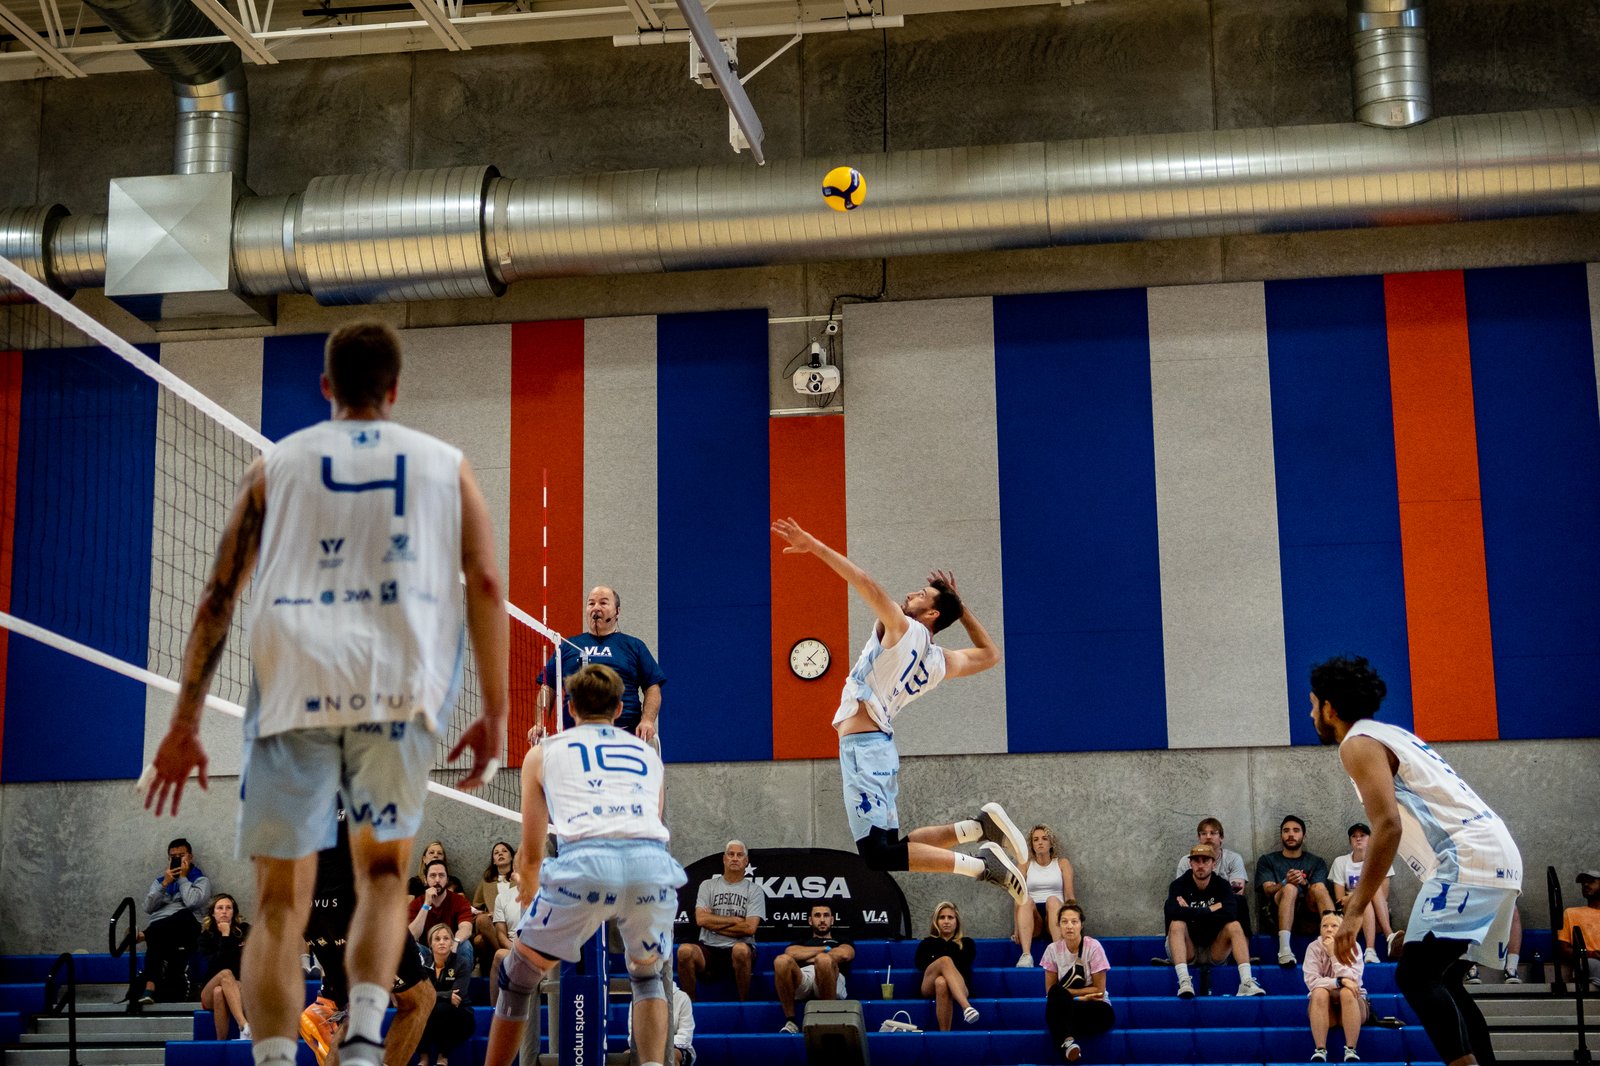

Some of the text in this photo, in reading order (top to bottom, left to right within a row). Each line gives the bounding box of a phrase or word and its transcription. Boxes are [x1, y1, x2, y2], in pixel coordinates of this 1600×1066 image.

[321, 454, 406, 517] 4
[584, 646, 613, 657] VLA
[567, 742, 648, 776] 16
[712, 892, 748, 909] ERSKINE
[773, 912, 808, 921] GAME
[862, 910, 889, 923] VLA
[573, 994, 585, 1066] sports impo
